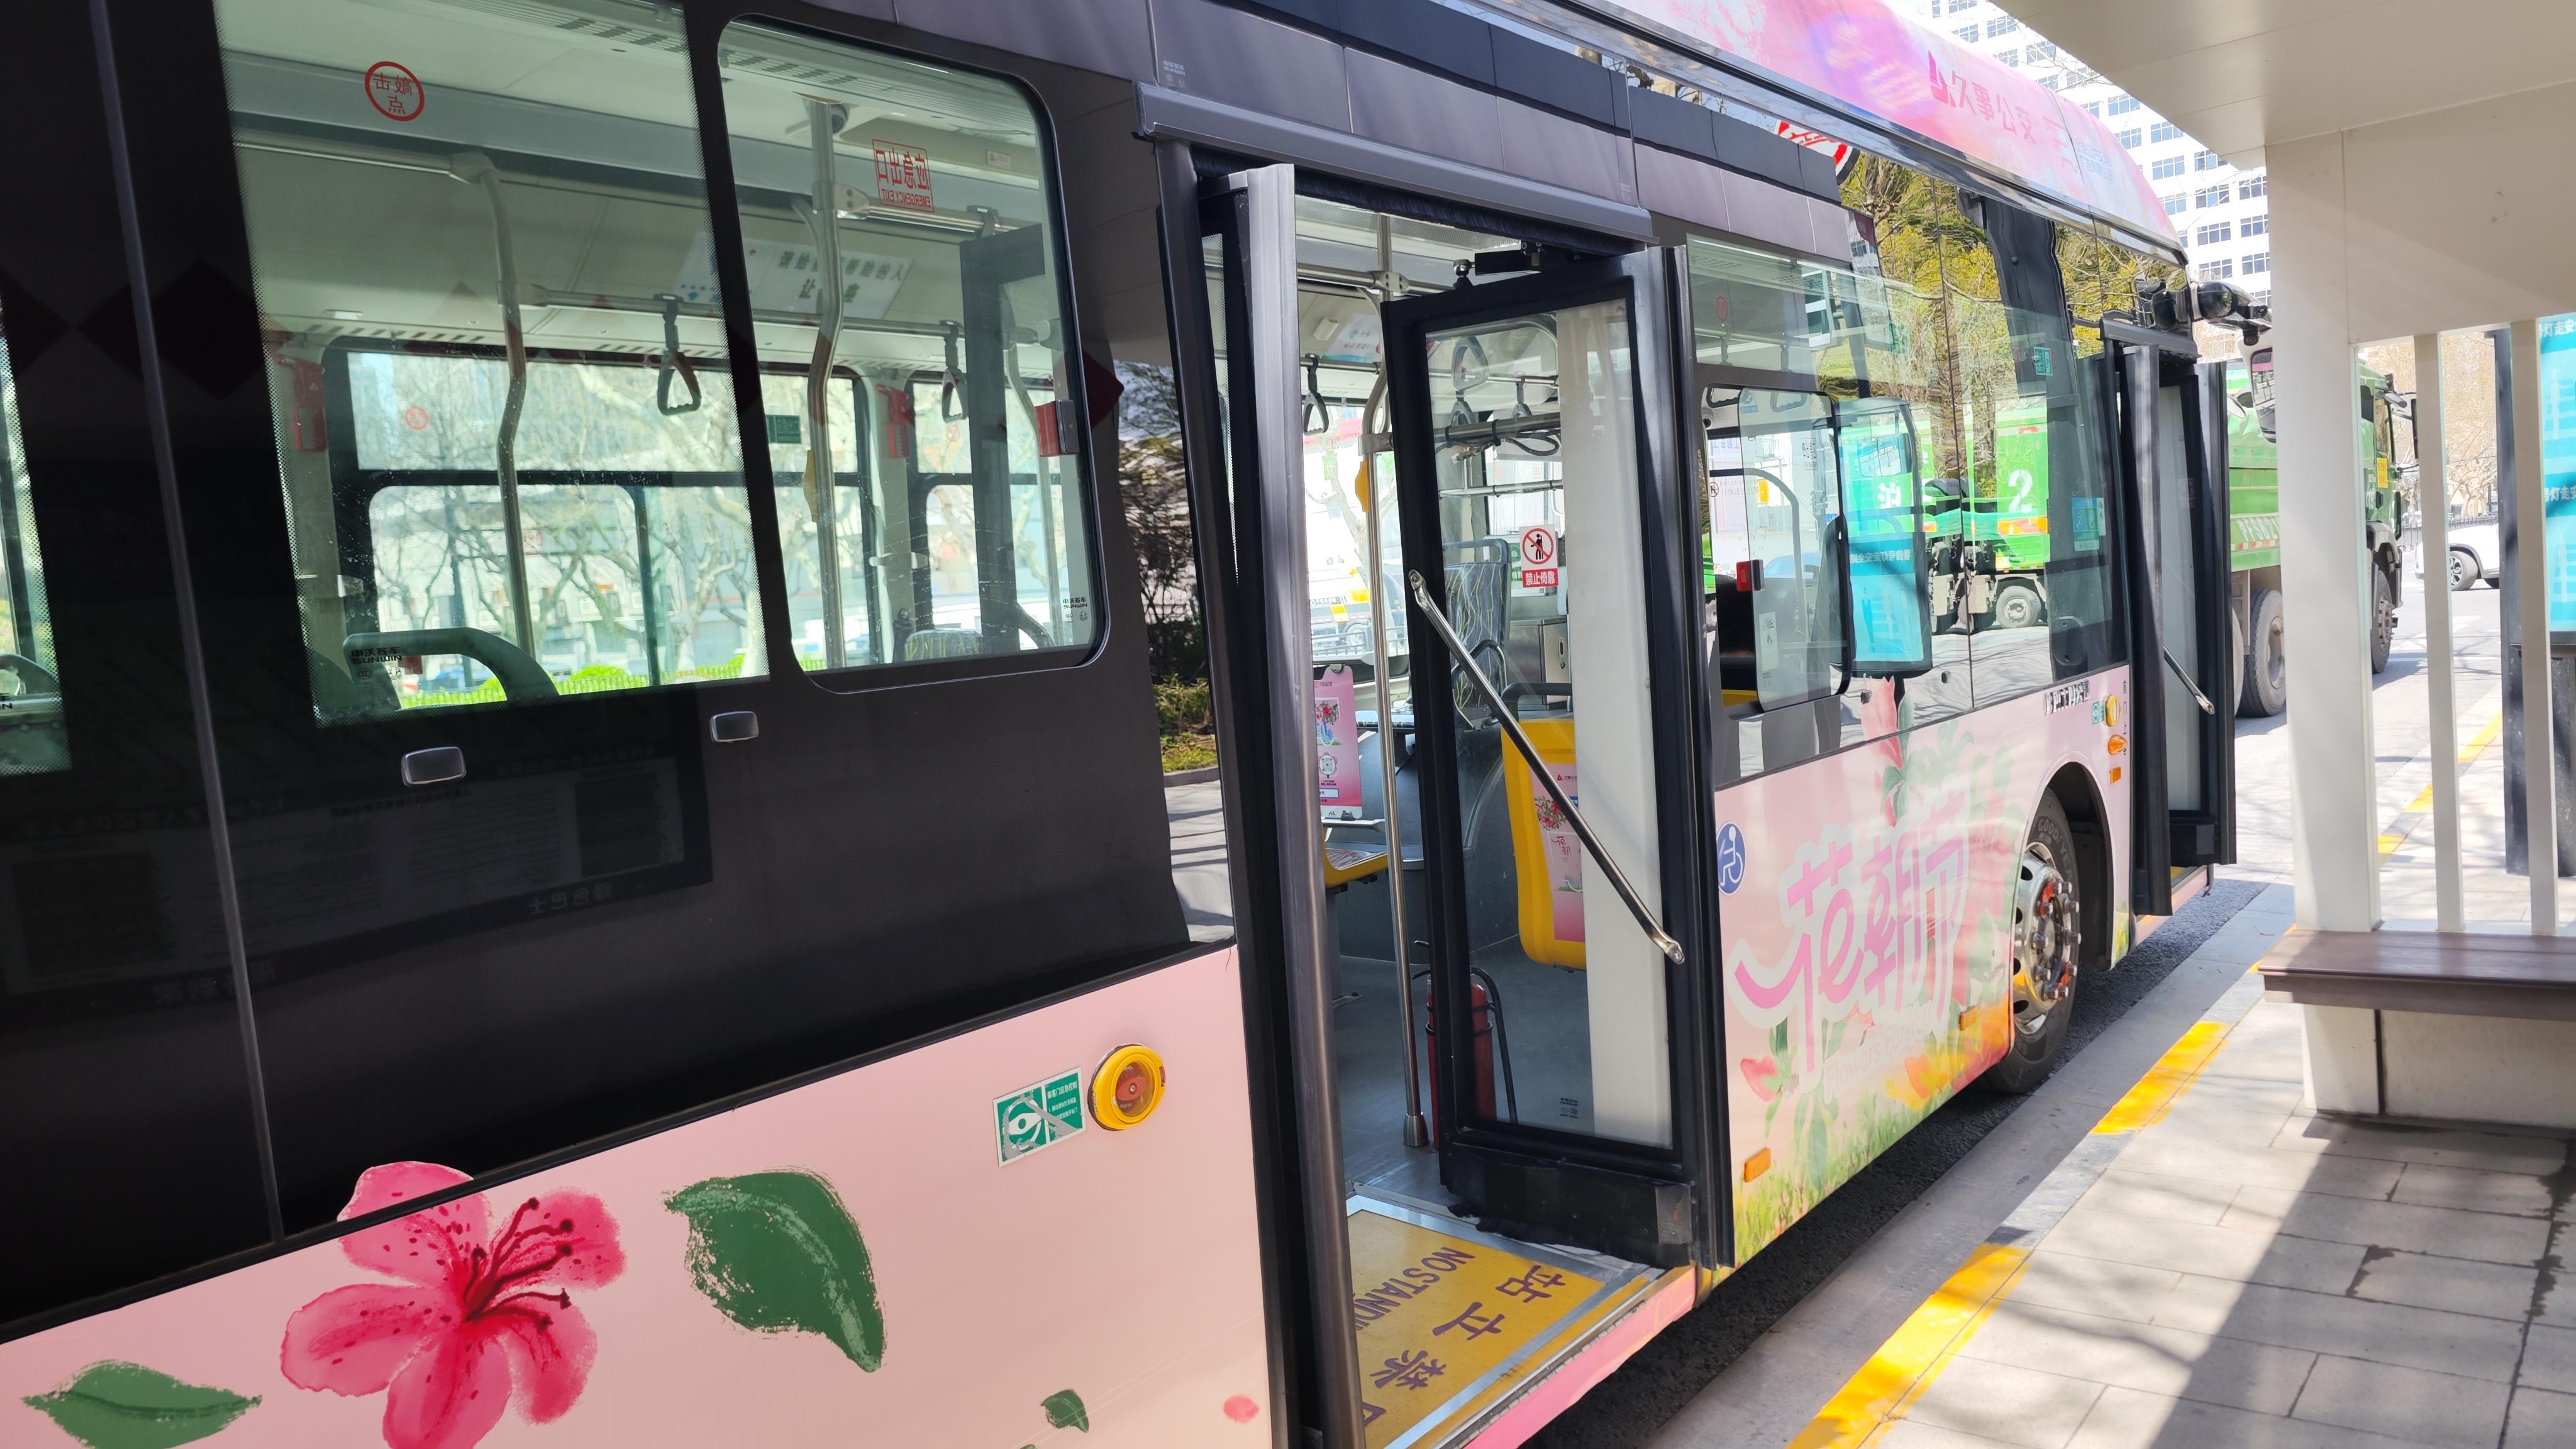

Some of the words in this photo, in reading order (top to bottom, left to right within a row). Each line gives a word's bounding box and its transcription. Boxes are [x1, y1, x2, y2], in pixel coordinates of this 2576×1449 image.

[2008, 469, 2033, 513] 2
[1525, 570, 1555, 586] 禁止倚靠
[352, 655, 402, 665] SUNWIN
[2038, 818, 2073, 886] GOODYEA
[1826, 1043, 1882, 1084] Flowers
[1884, 1026, 1906, 1056] For
[1908, 1009, 1933, 1036] You
[1421, 1246, 1475, 1272] NO
